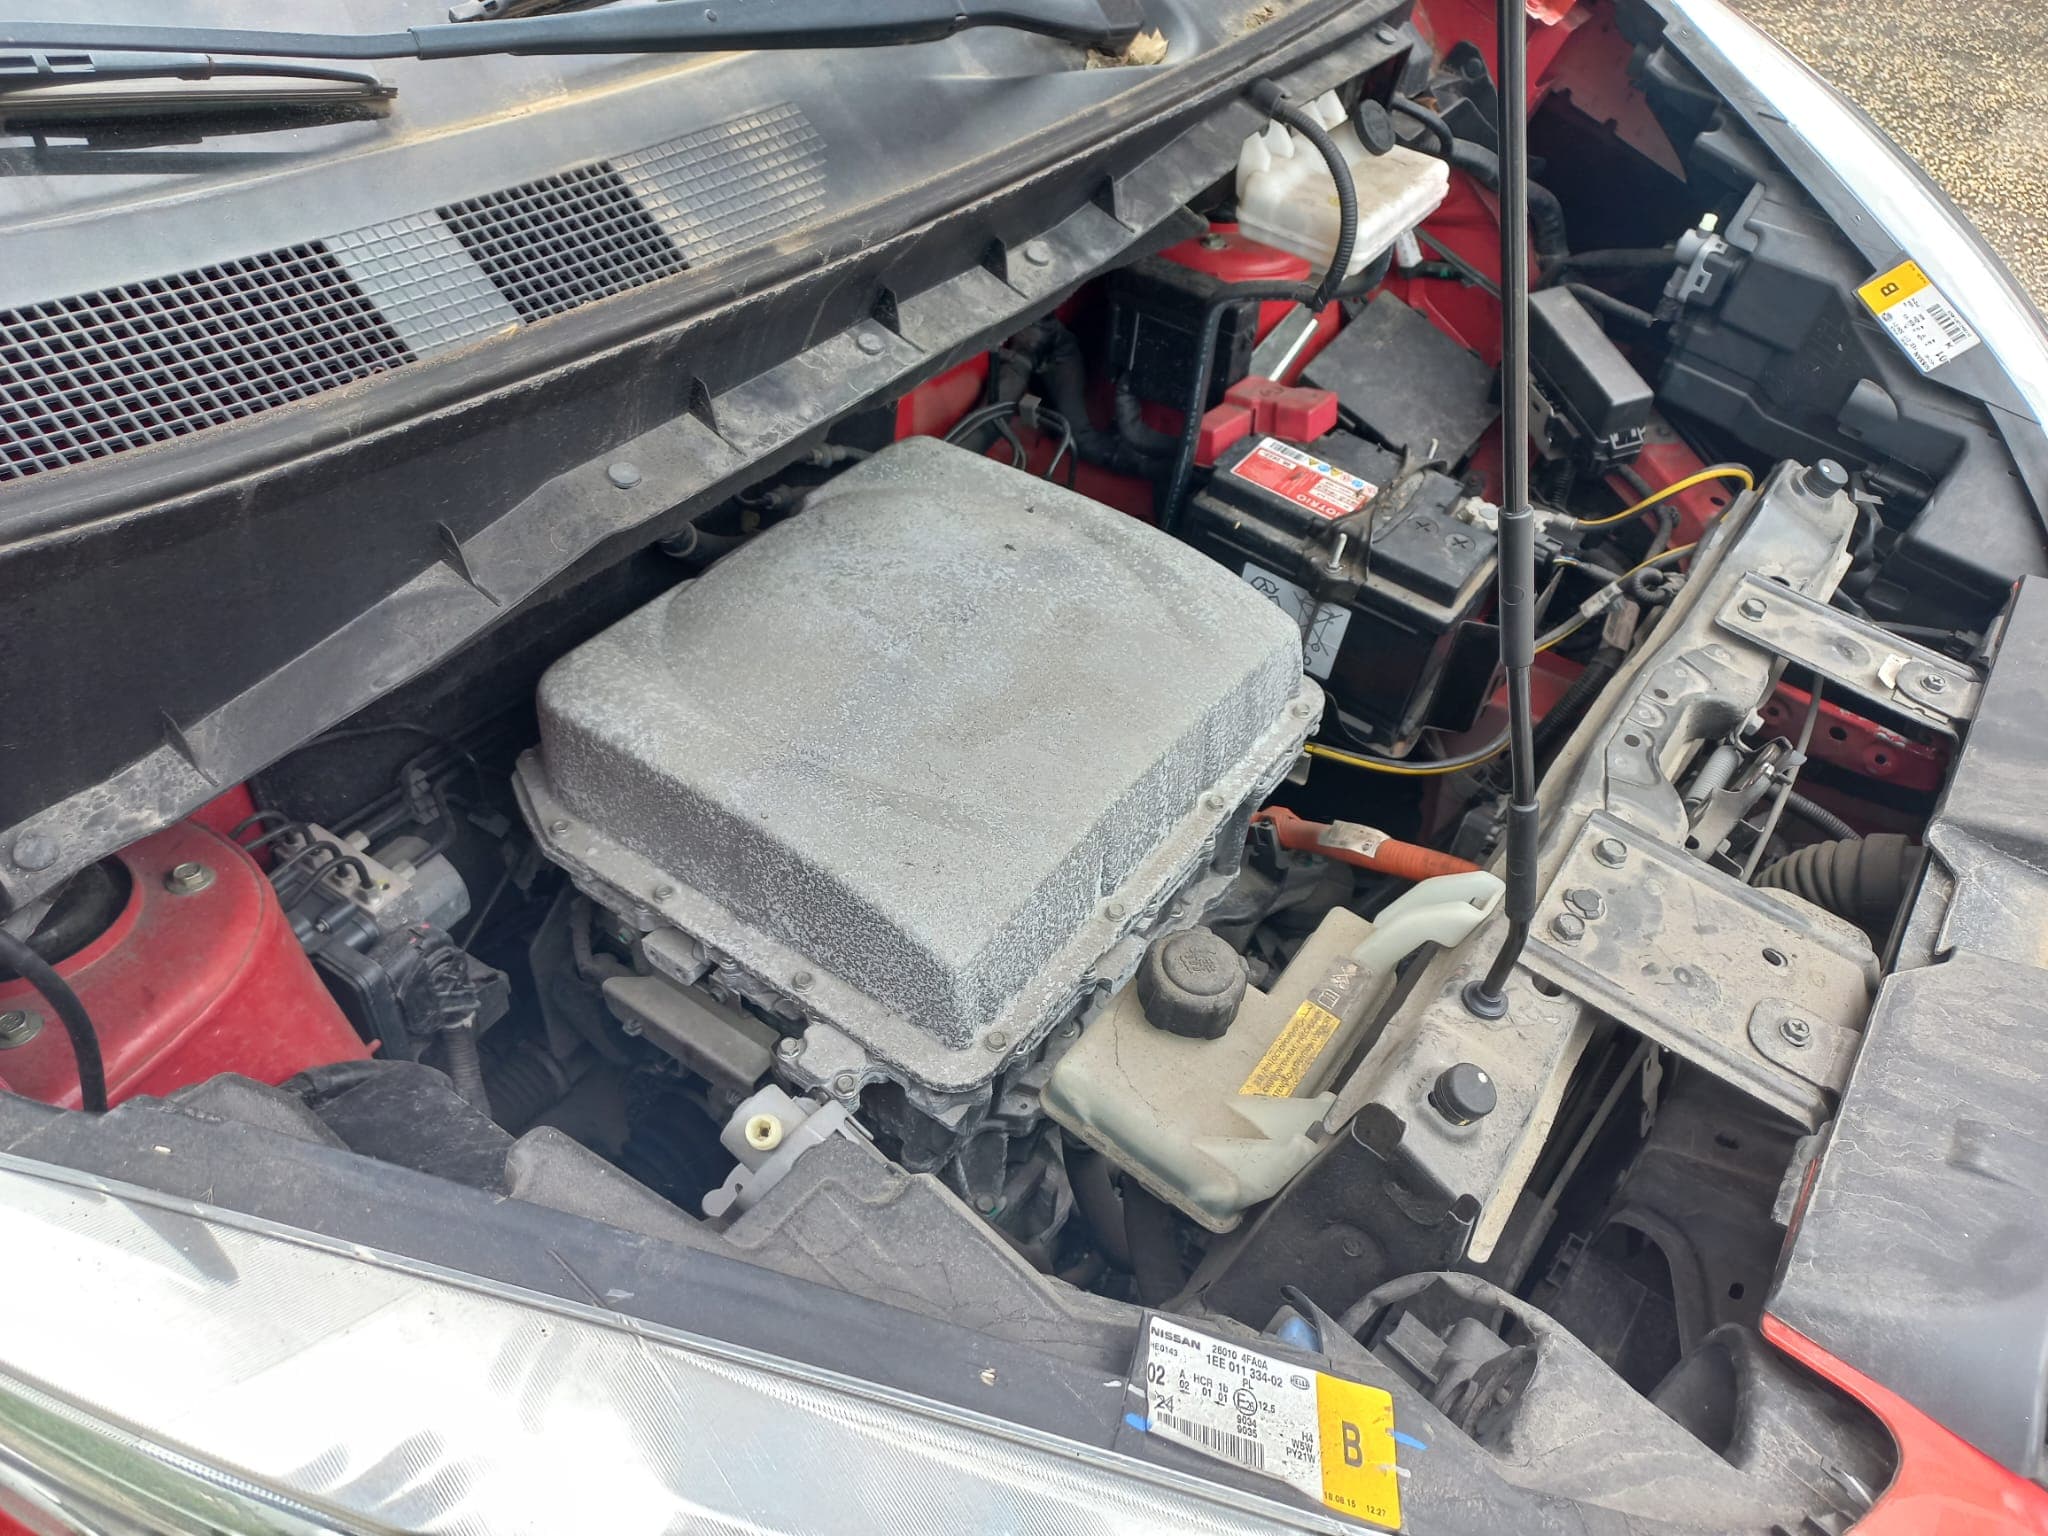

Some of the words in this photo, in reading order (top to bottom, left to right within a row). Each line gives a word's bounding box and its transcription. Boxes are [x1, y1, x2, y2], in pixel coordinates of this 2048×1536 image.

[1880, 282, 1900, 297] B
[1296, 493, 1341, 517] OTRIO
[1151, 1326, 1201, 1350] NISSAN
[1212, 1344, 1238, 1360] 26010
[1147, 1362, 1166, 1386] 02
[1206, 1354, 1226, 1370] 1EE
[1228, 1361, 1247, 1377] 011
[1249, 1367, 1284, 1388] 334-02
[1242, 1379, 1254, 1390] PL
[1237, 1425, 1258, 1439] 9035
[1302, 1431, 1314, 1444] H4
[1291, 1438, 1314, 1454] W5W
[1341, 1419, 1364, 1468] B
